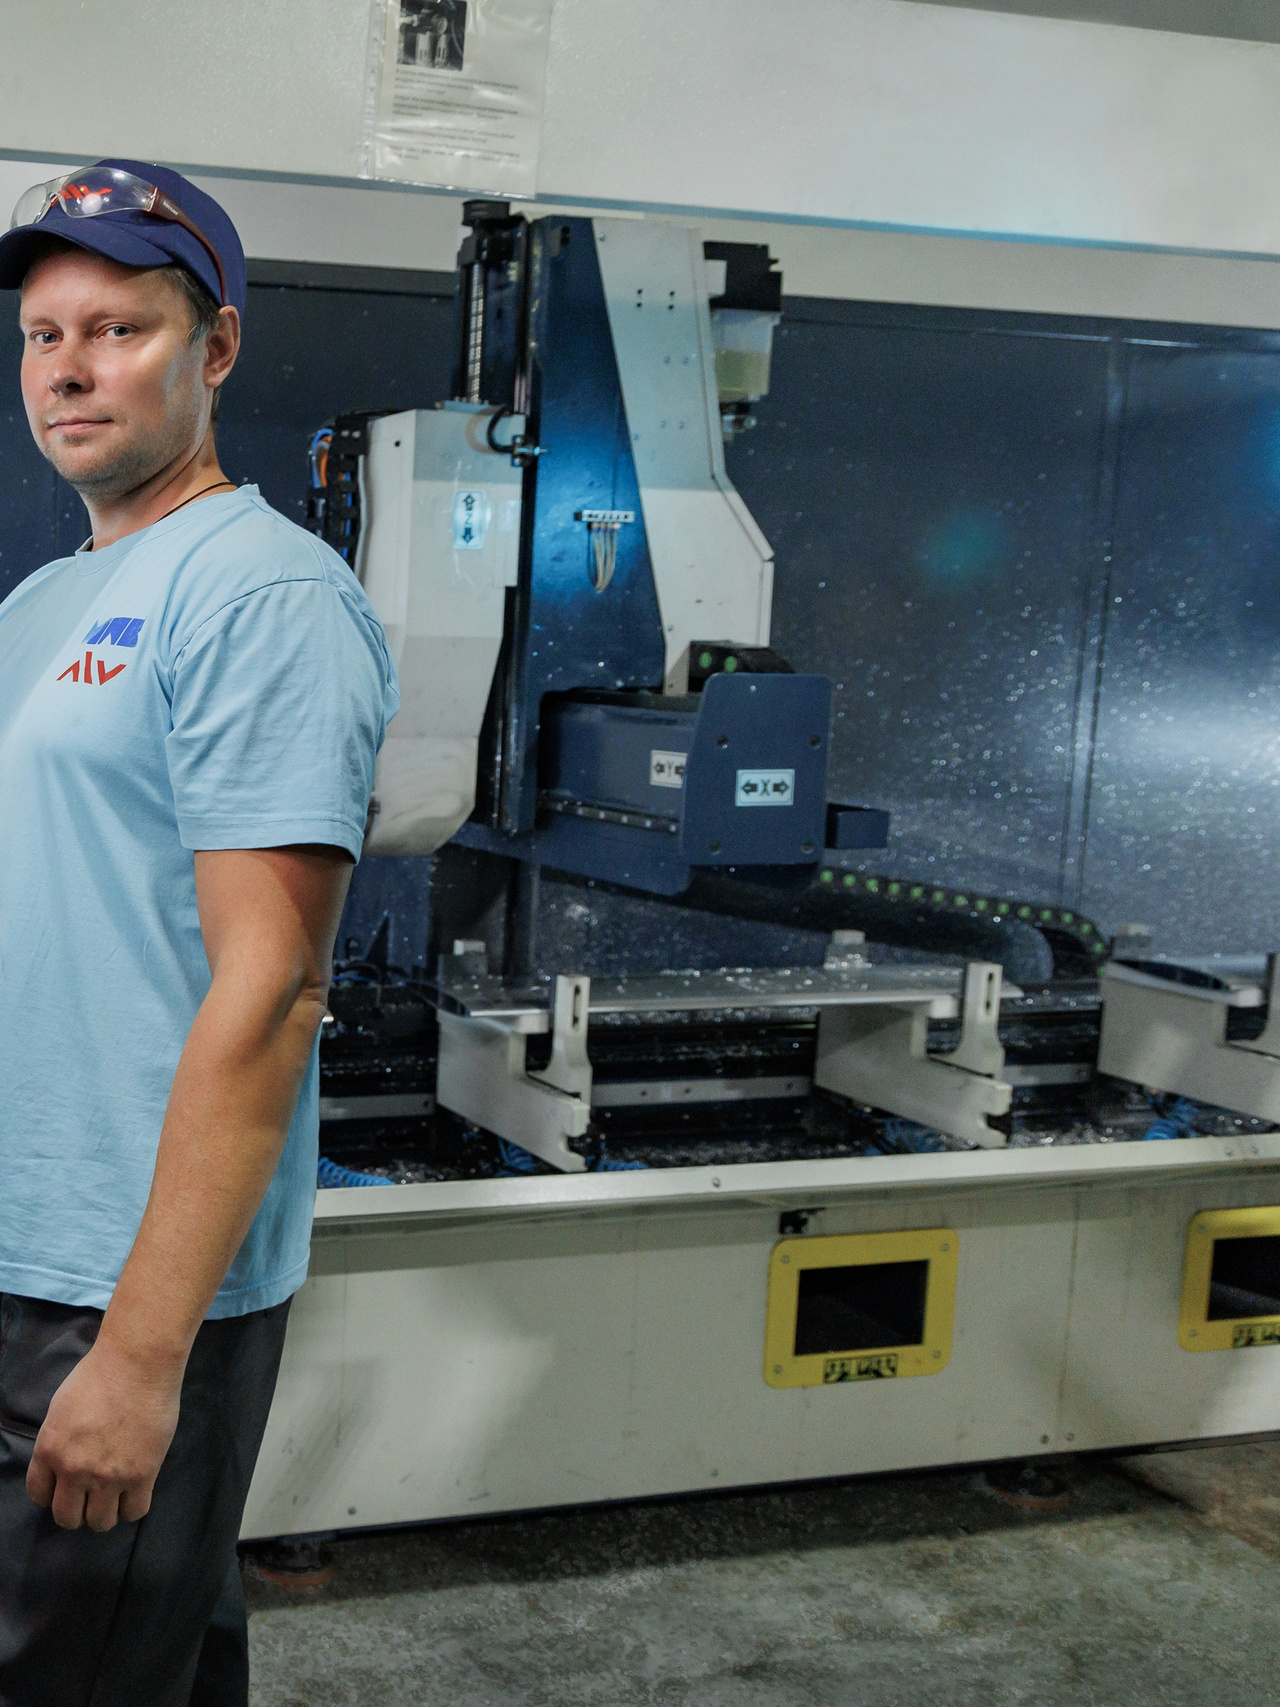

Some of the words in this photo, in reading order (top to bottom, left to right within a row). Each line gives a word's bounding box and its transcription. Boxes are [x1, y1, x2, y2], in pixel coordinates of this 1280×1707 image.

[465, 513, 473, 525] Z
[666, 761, 674, 778] Y
[760, 779, 771, 796] X
